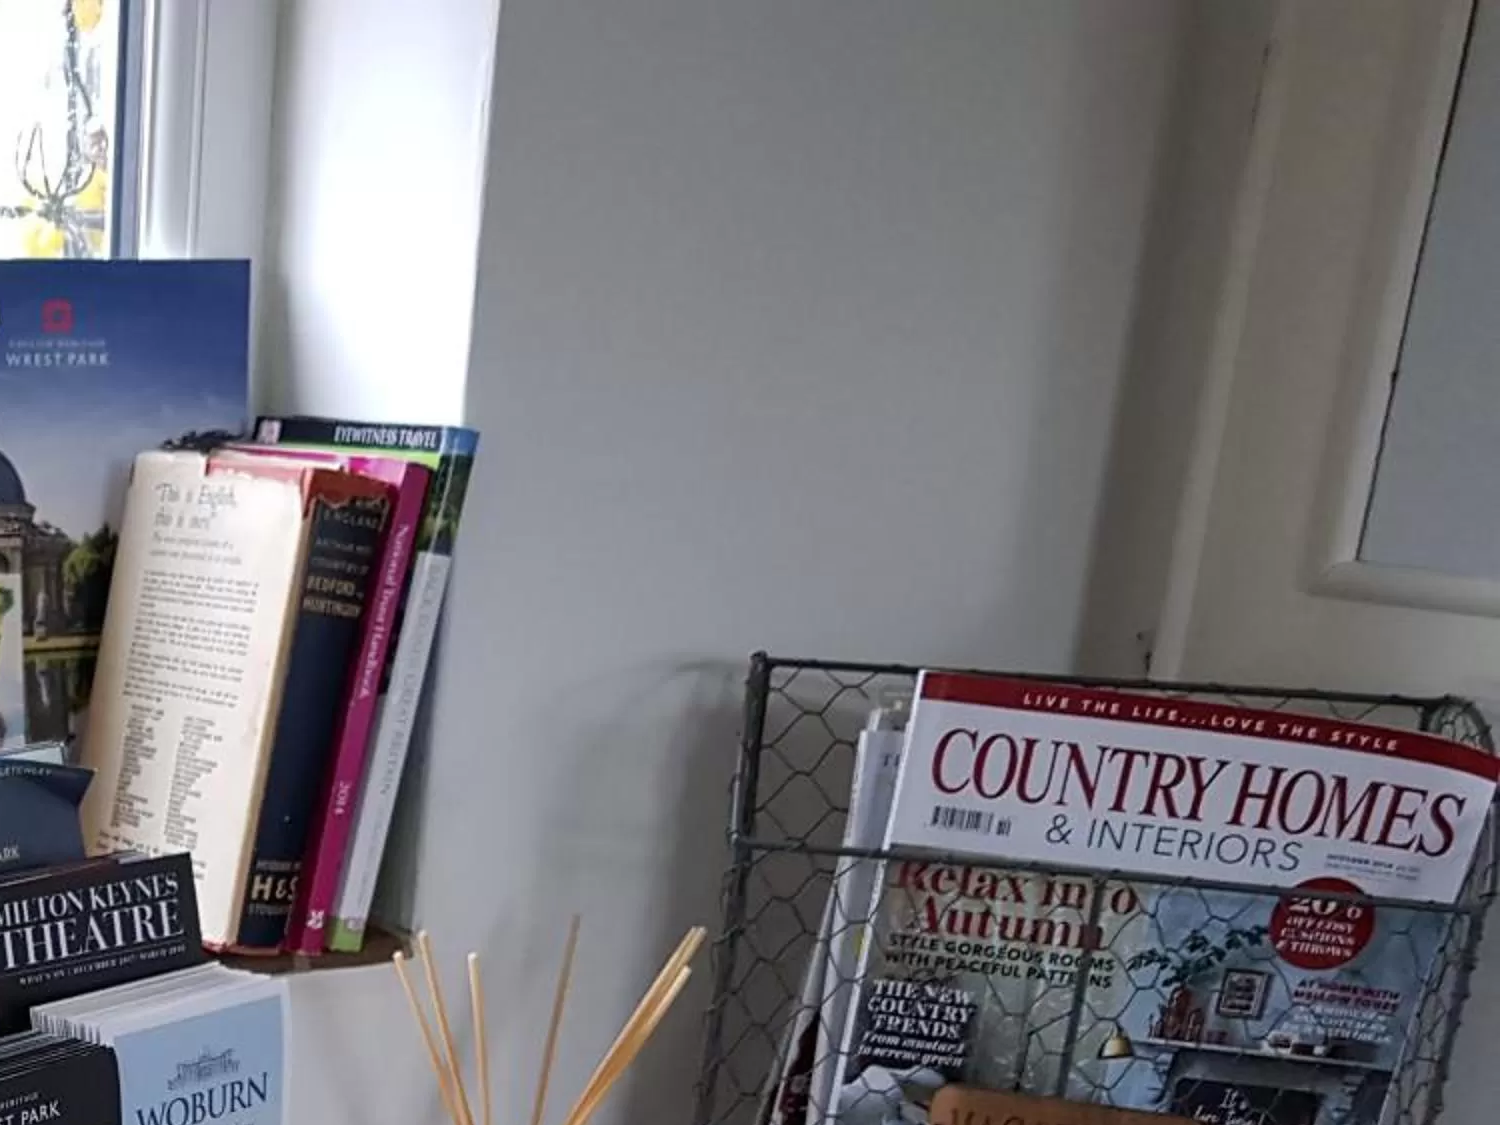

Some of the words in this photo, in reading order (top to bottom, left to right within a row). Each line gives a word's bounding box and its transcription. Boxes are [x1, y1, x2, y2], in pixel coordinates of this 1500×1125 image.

[334, 425, 398, 446] EYEWITNESS
[400, 428, 438, 448] TRAVEL
[1023, 692, 1070, 710] LIVE
[1081, 699, 1120, 715] THE
[1277, 722, 1319, 740] THE
[1328, 731, 1399, 752] STYLE
[931, 727, 1229, 822] COUNTRY
[1226, 762, 1467, 858] HOMES
[1045, 813, 1072, 846] &
[1086, 816, 1304, 873] INTERIORS
[90, 871, 179, 912] KEYNES
[1039, 875, 1138, 916] ino
[889, 932, 940, 951] STYLE
[944, 936, 1043, 964] GORGEOUS
[873, 978, 921, 999] THE
[884, 952, 931, 969] WITH
[934, 957, 1021, 979] PEACEFUL
[1026, 967, 1113, 989] PATTENS
[867, 995, 974, 1023] COUNTRY
